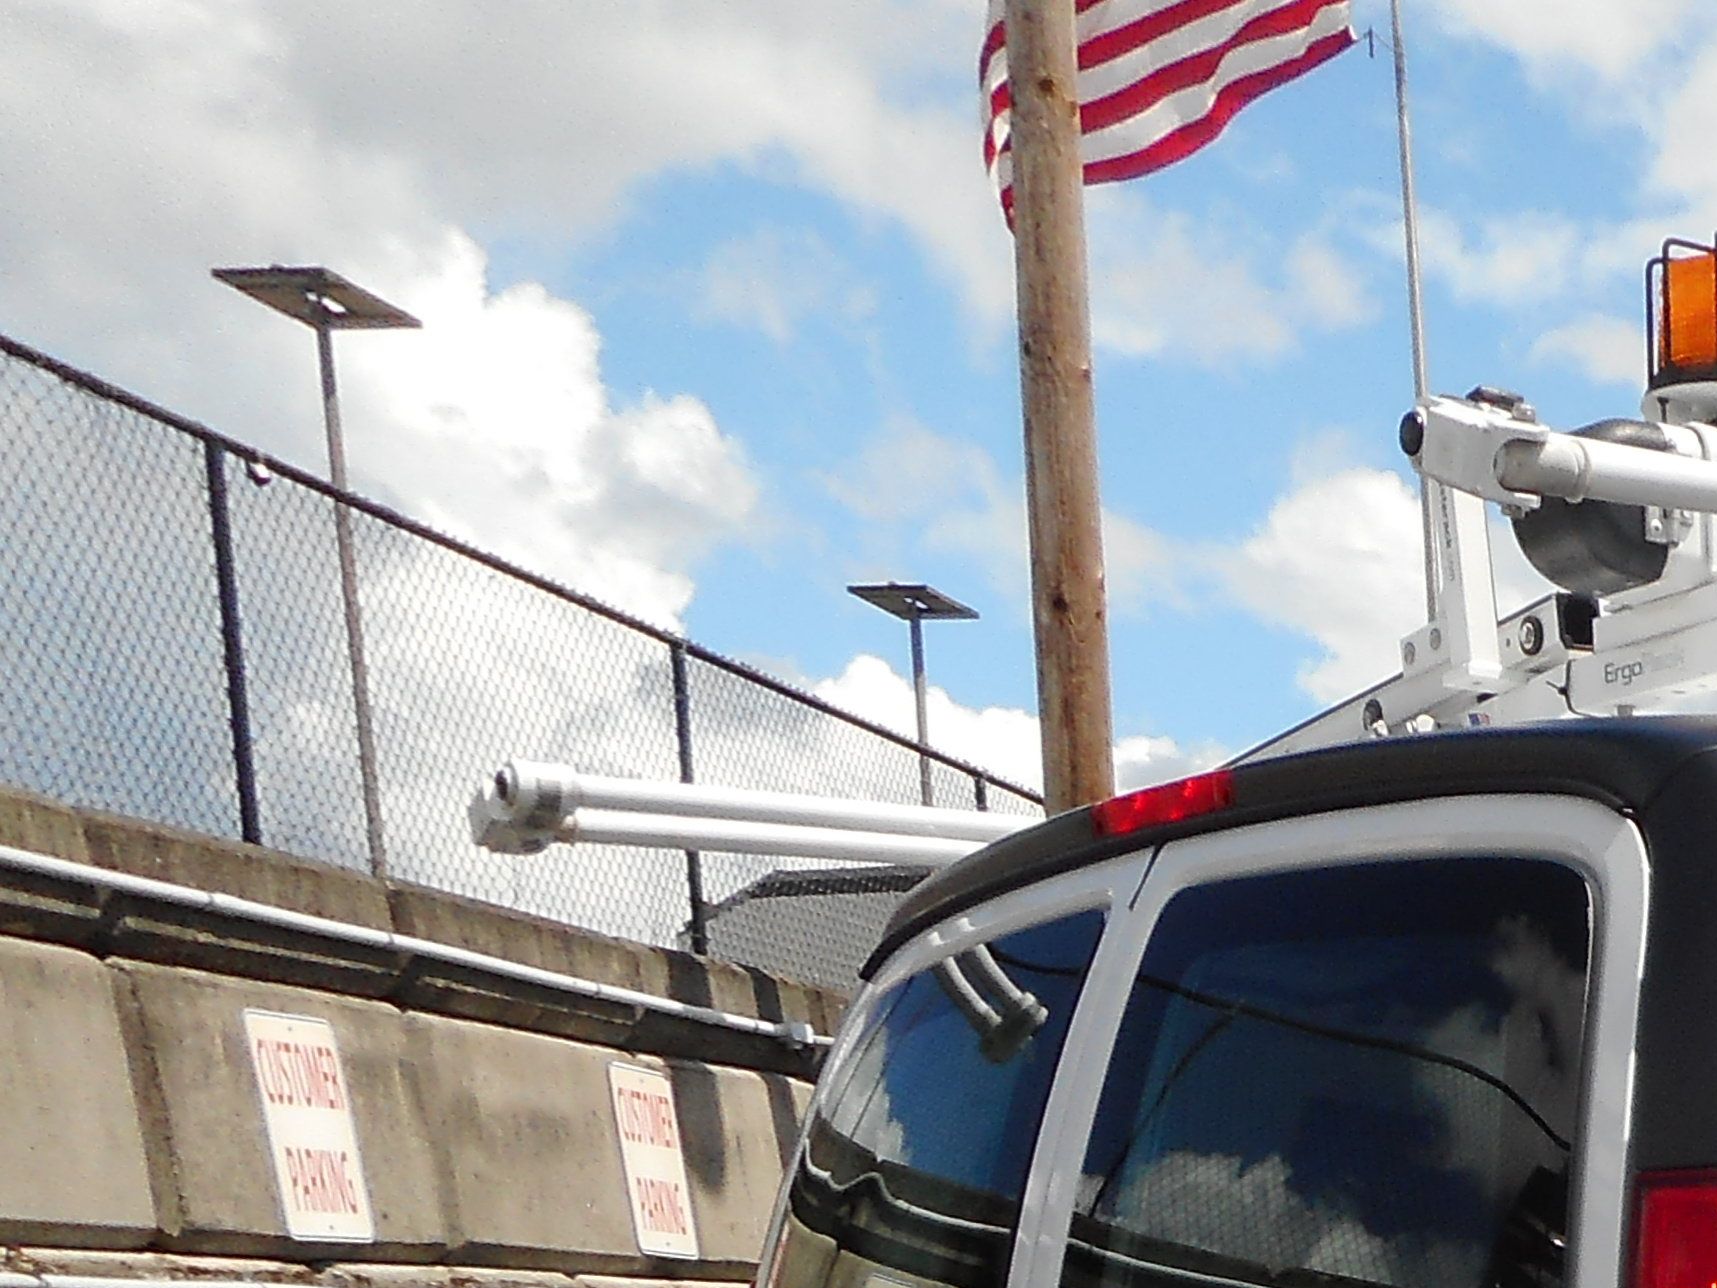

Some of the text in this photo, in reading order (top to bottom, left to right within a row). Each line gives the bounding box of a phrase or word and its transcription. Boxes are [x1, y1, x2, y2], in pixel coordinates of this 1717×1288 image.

[1604, 660, 1643, 686] Ergo
[256, 1038, 346, 1109] CUSTOMER
[618, 1086, 678, 1149] CUSTOMER
[286, 1146, 358, 1214] PARKING
[636, 1176, 687, 1235] PARKING
